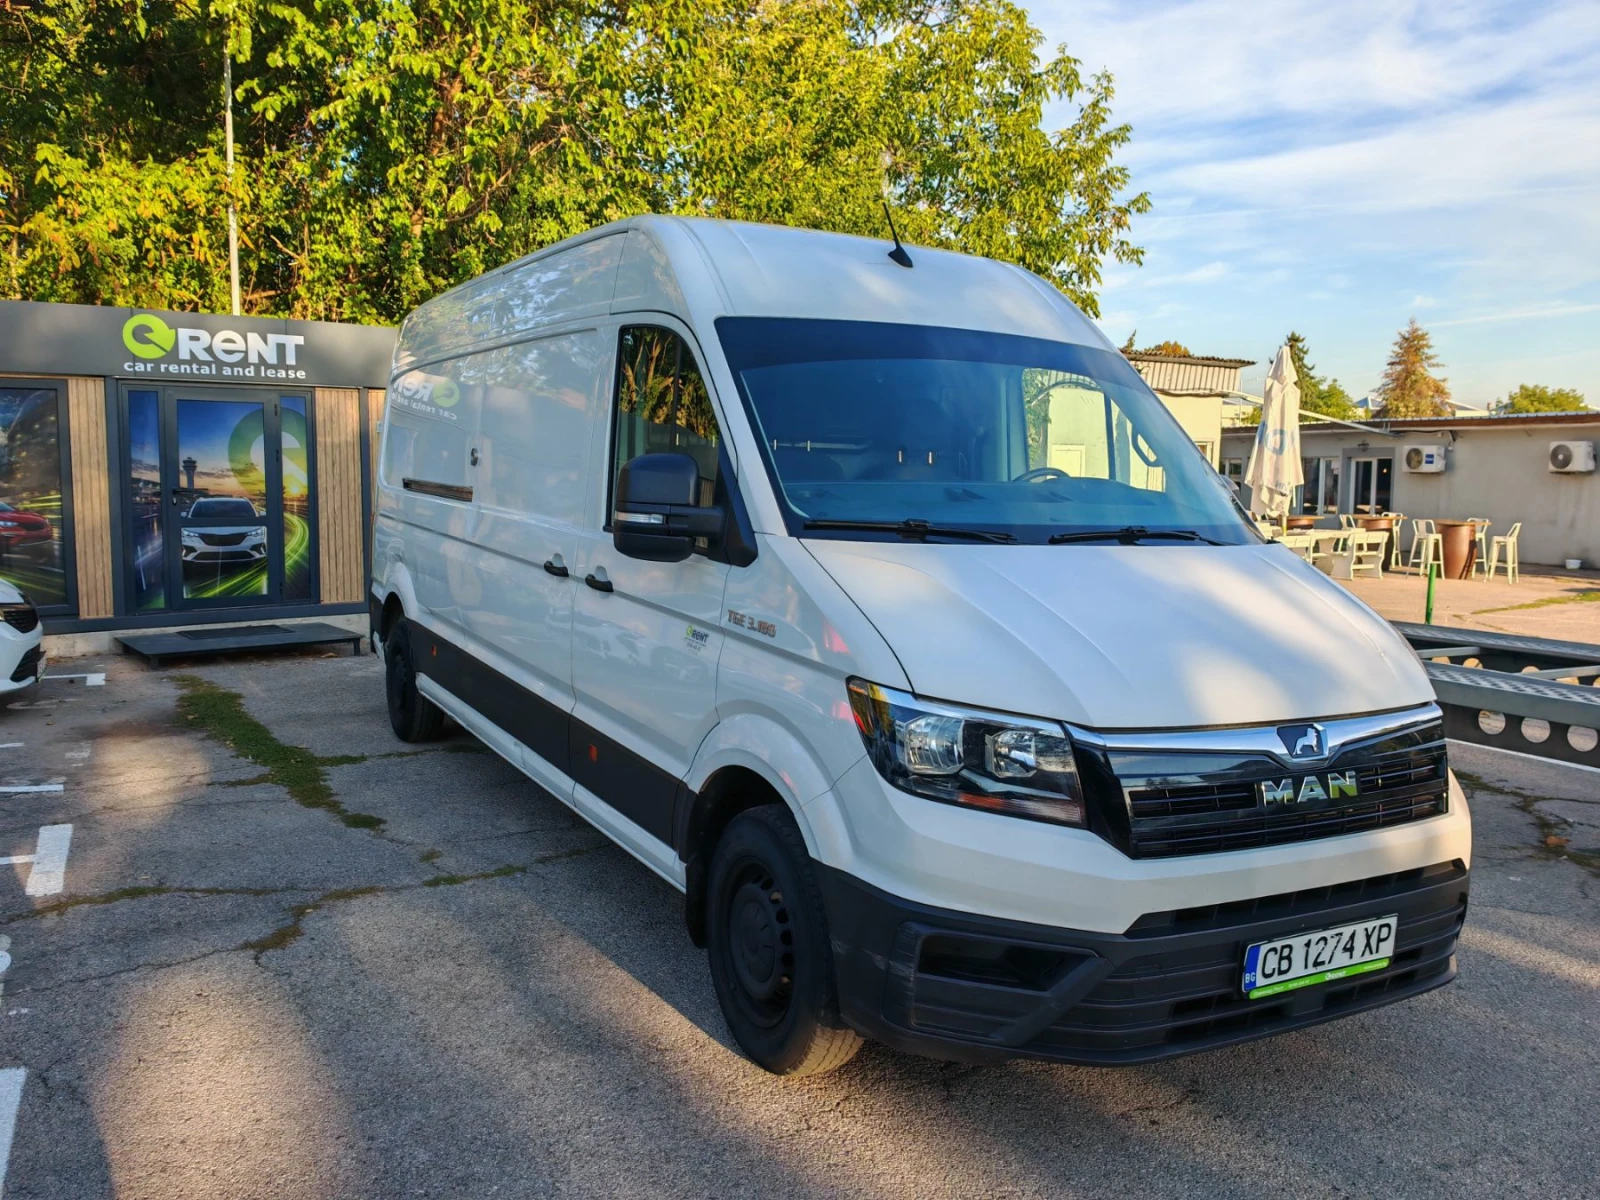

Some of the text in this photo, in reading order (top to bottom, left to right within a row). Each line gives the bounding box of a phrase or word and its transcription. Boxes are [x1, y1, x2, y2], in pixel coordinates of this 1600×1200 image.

[123, 361, 306, 379] car rental and lease
[1261, 771, 1358, 807] MAN
[1261, 922, 1392, 979] CB 1274 XP
[1245, 972, 1256, 984] BG
